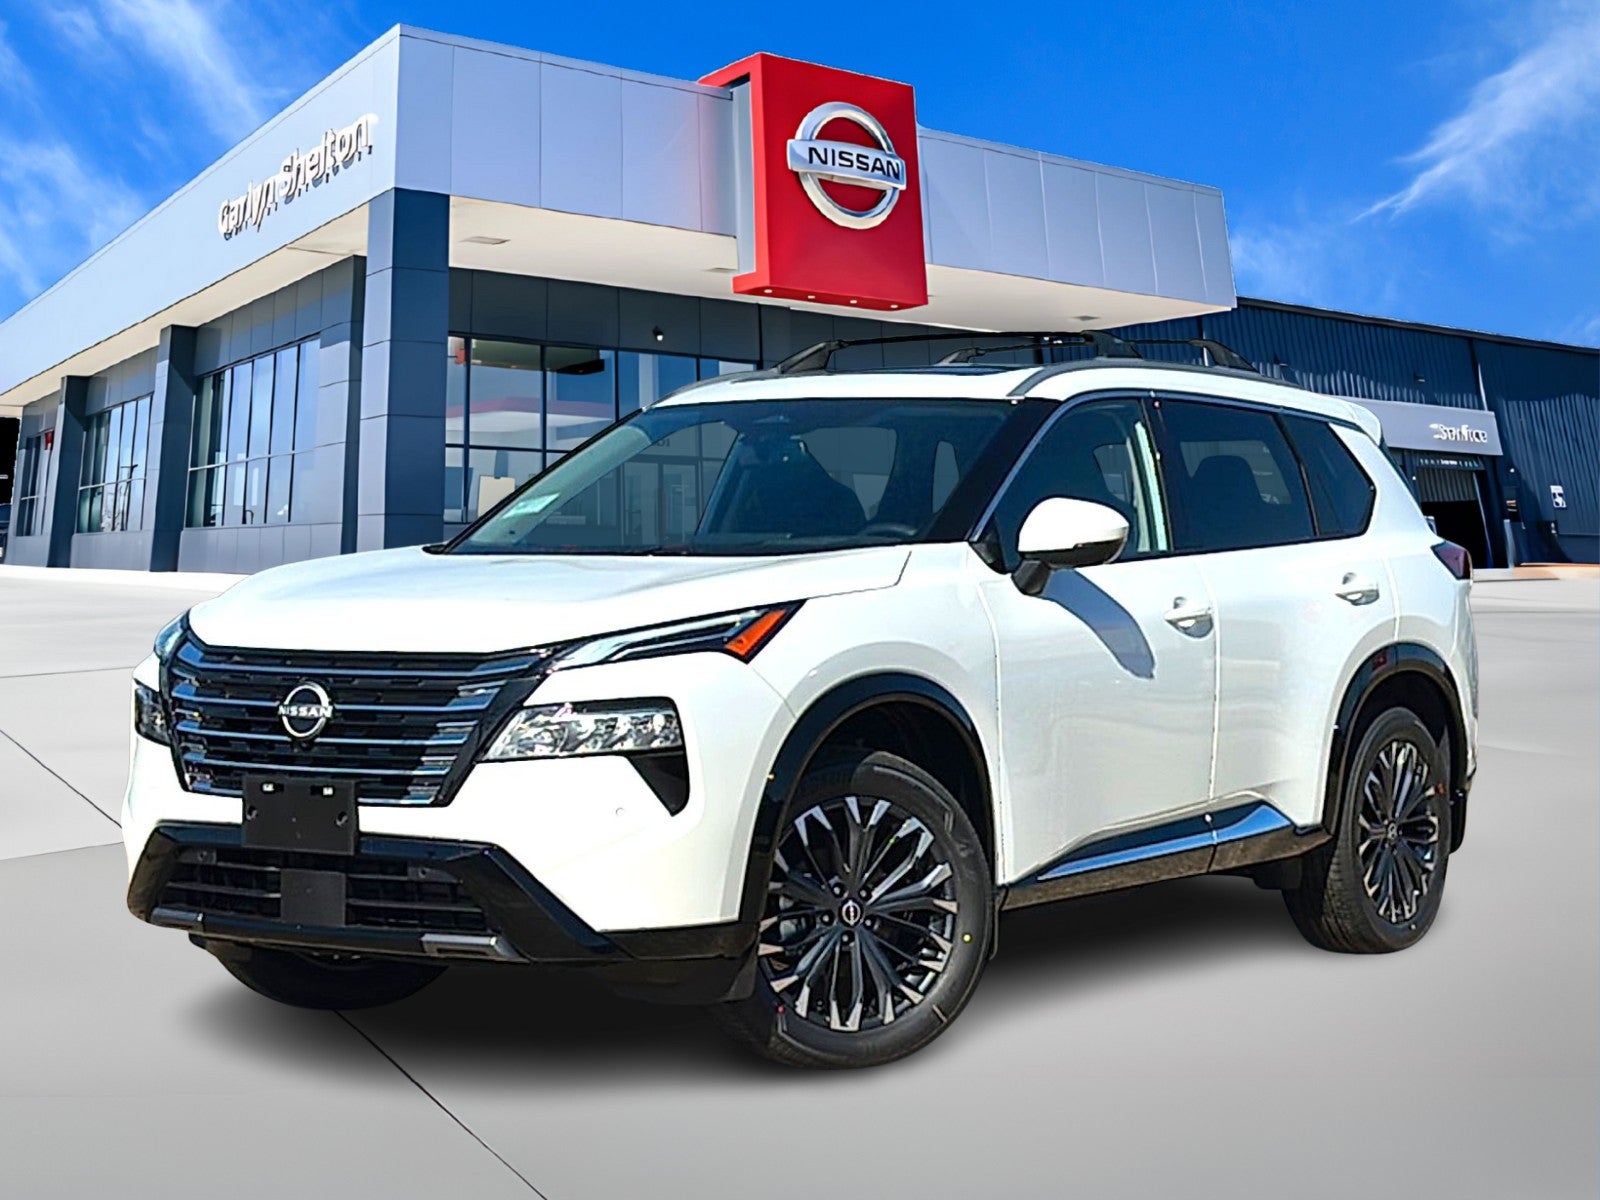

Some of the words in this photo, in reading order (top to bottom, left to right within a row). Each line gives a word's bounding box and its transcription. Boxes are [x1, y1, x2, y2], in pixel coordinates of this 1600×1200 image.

[278, 115, 377, 203] Shelton
[808, 147, 901, 180] NISSAN
[278, 705, 333, 718] NISSAN
